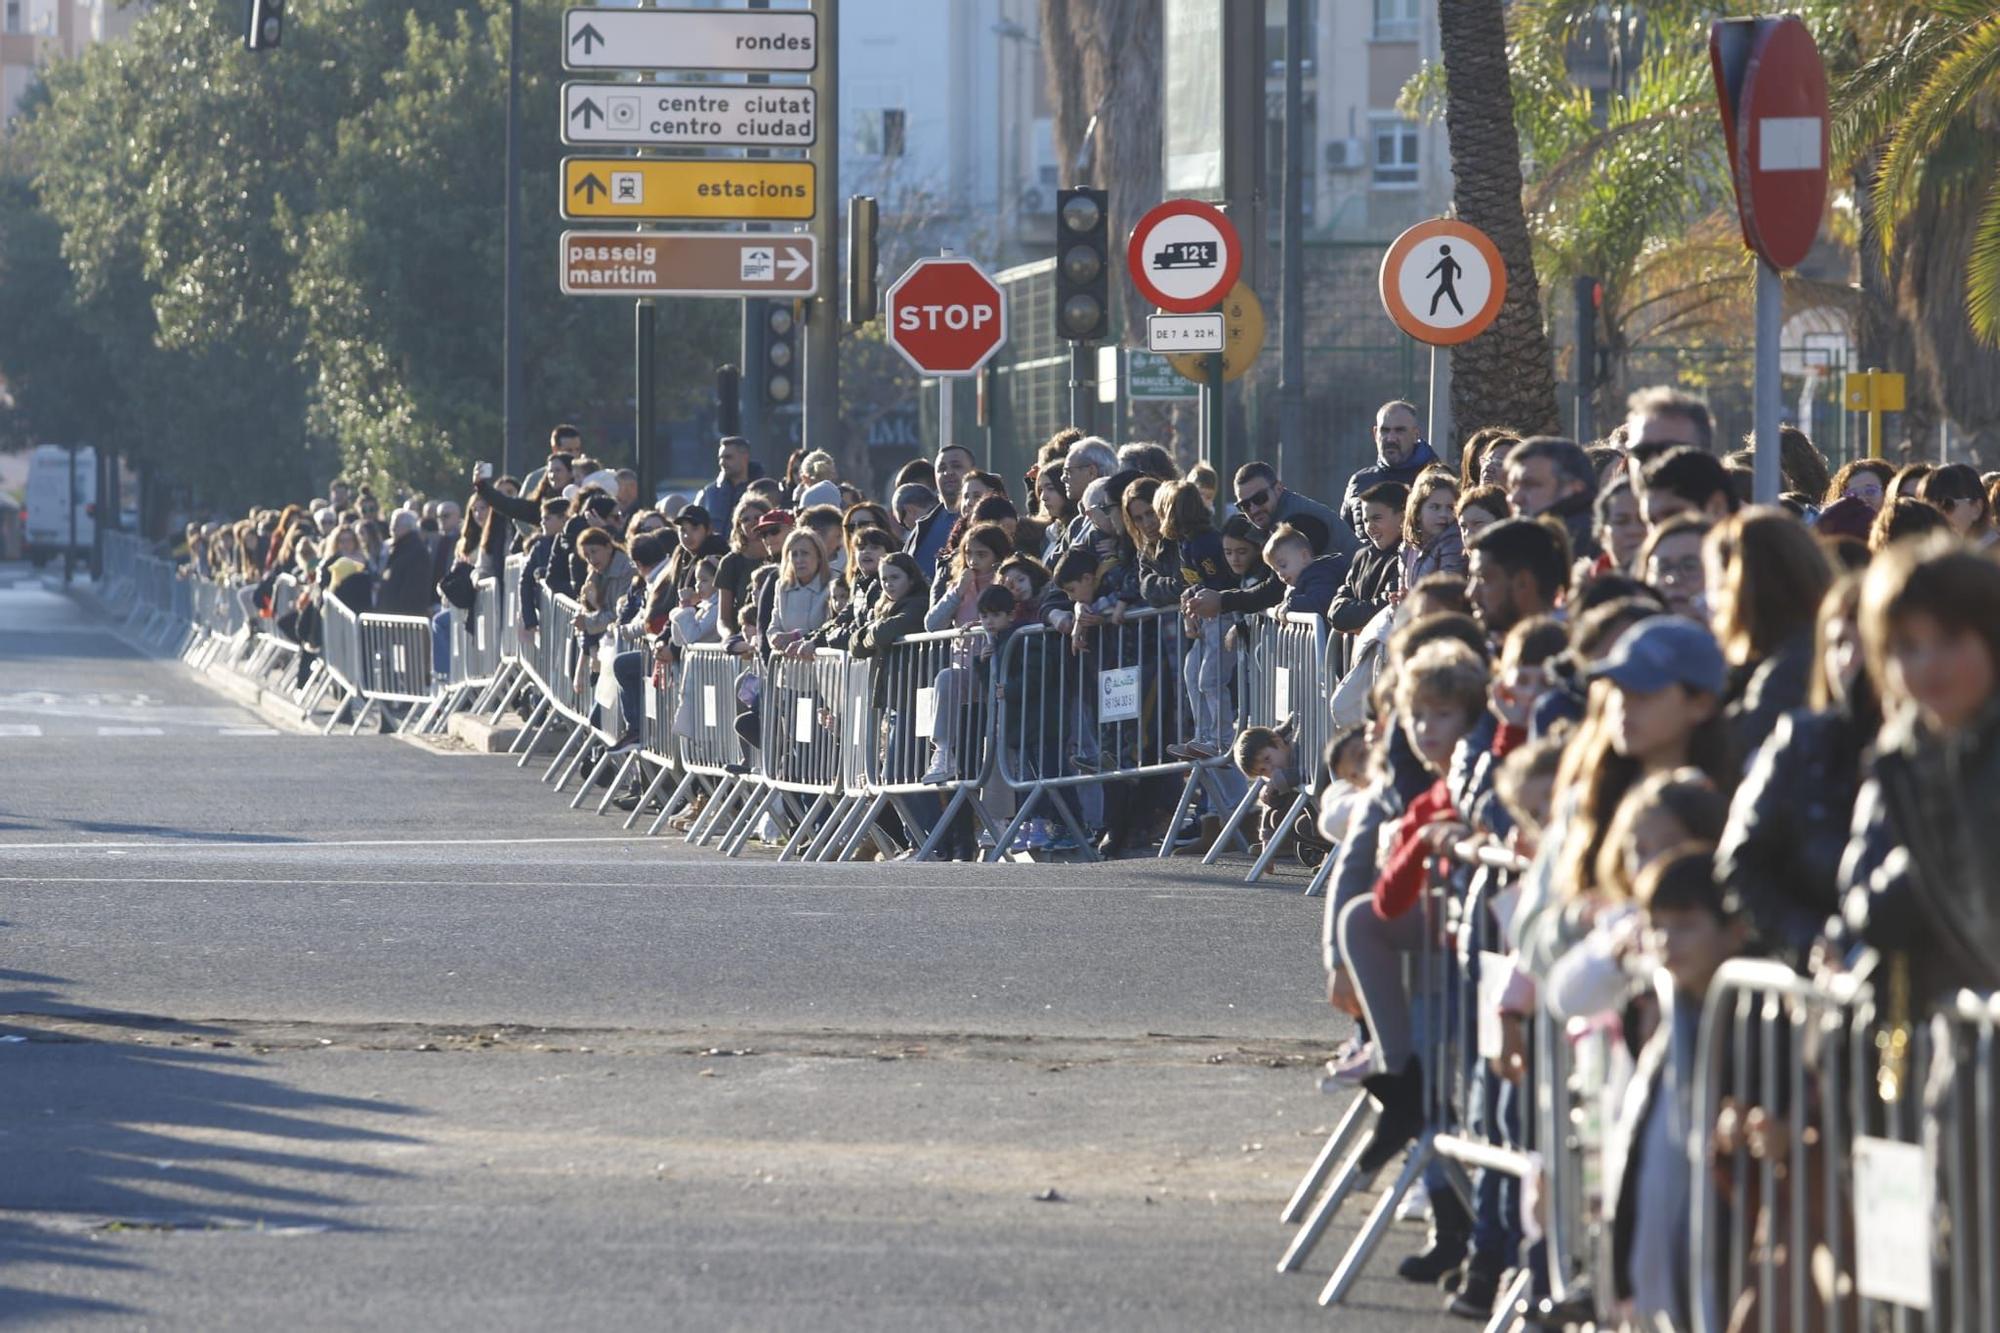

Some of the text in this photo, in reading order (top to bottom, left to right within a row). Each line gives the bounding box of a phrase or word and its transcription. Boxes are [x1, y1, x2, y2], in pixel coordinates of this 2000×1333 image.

[736, 33, 811, 50] rondes
[658, 95, 811, 114] centre ciutat
[650, 118, 811, 137] centro ciudad
[697, 179, 806, 197] estacions
[569, 243, 657, 264] passeig
[1180, 245, 1209, 260] 12t
[569, 265, 657, 284] marítim
[899, 304, 993, 331] STOP
[1156, 330, 1168, 339] DE
[1171, 330, 1177, 338] 7
[1183, 329, 1189, 338] A
[1195, 329, 1205, 338] 22
